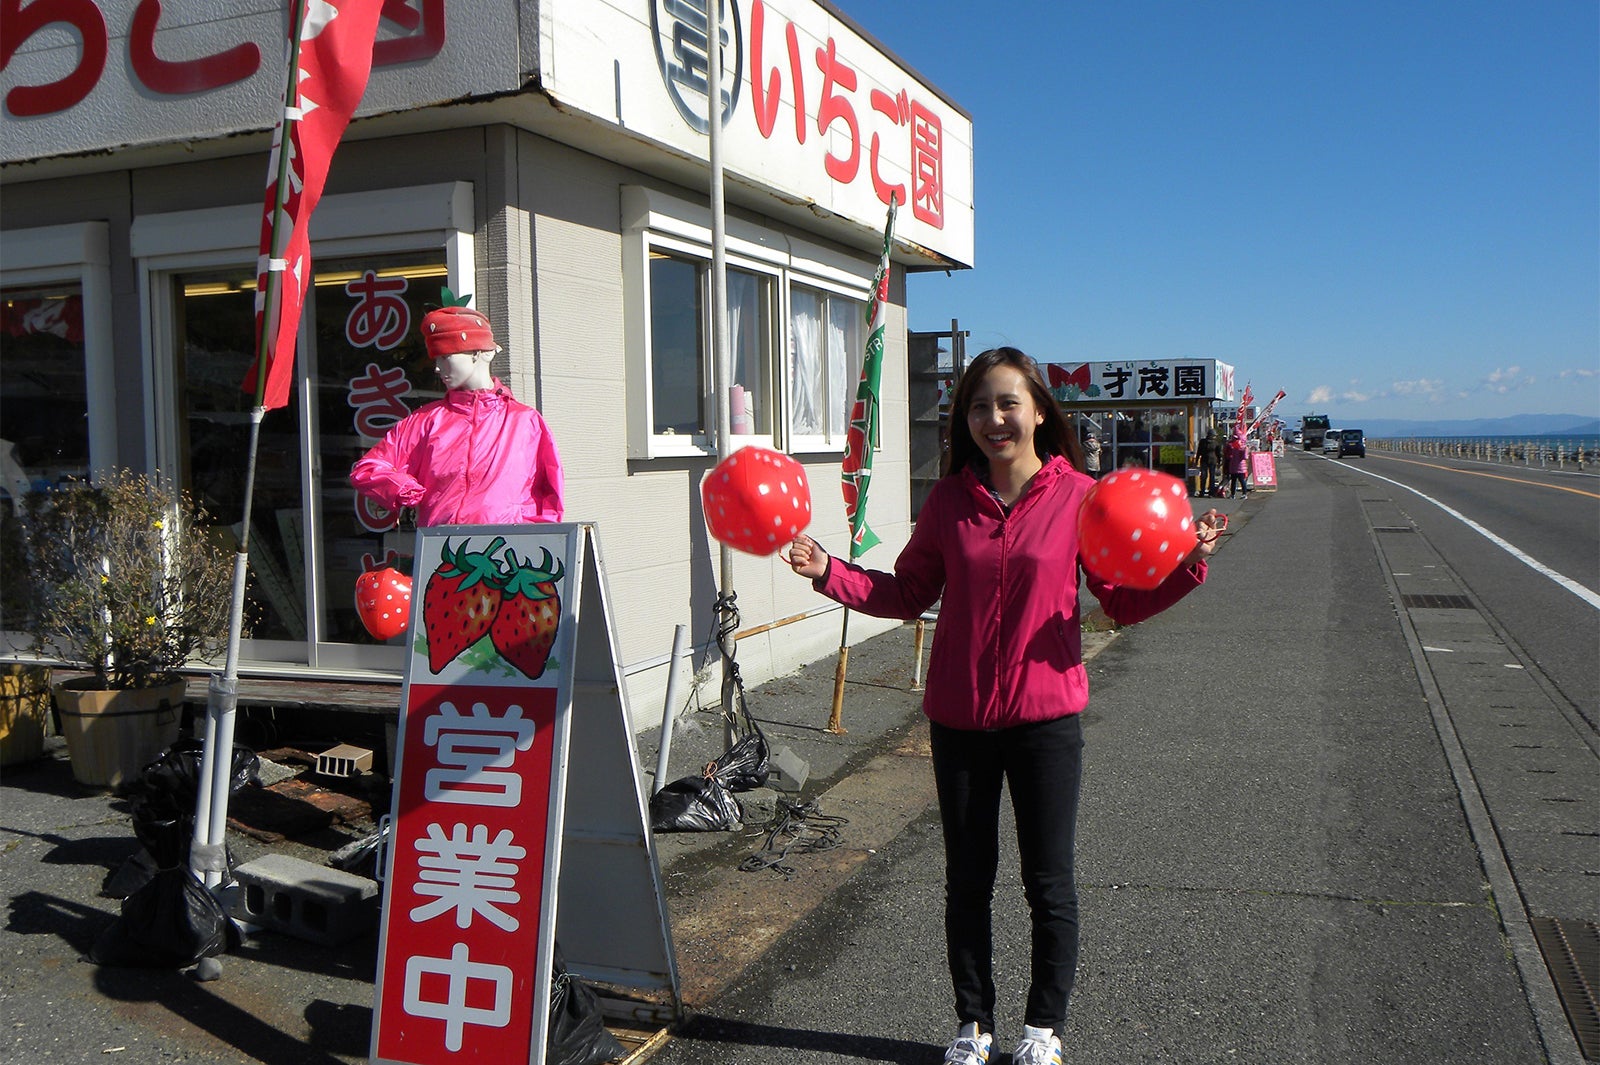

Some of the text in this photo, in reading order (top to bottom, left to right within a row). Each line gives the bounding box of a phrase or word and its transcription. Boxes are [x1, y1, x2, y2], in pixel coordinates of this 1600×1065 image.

[750, 0, 945, 230] いちご園
[1102, 366, 1206, 398] 才茂園
[402, 701, 536, 1053] 営業中
